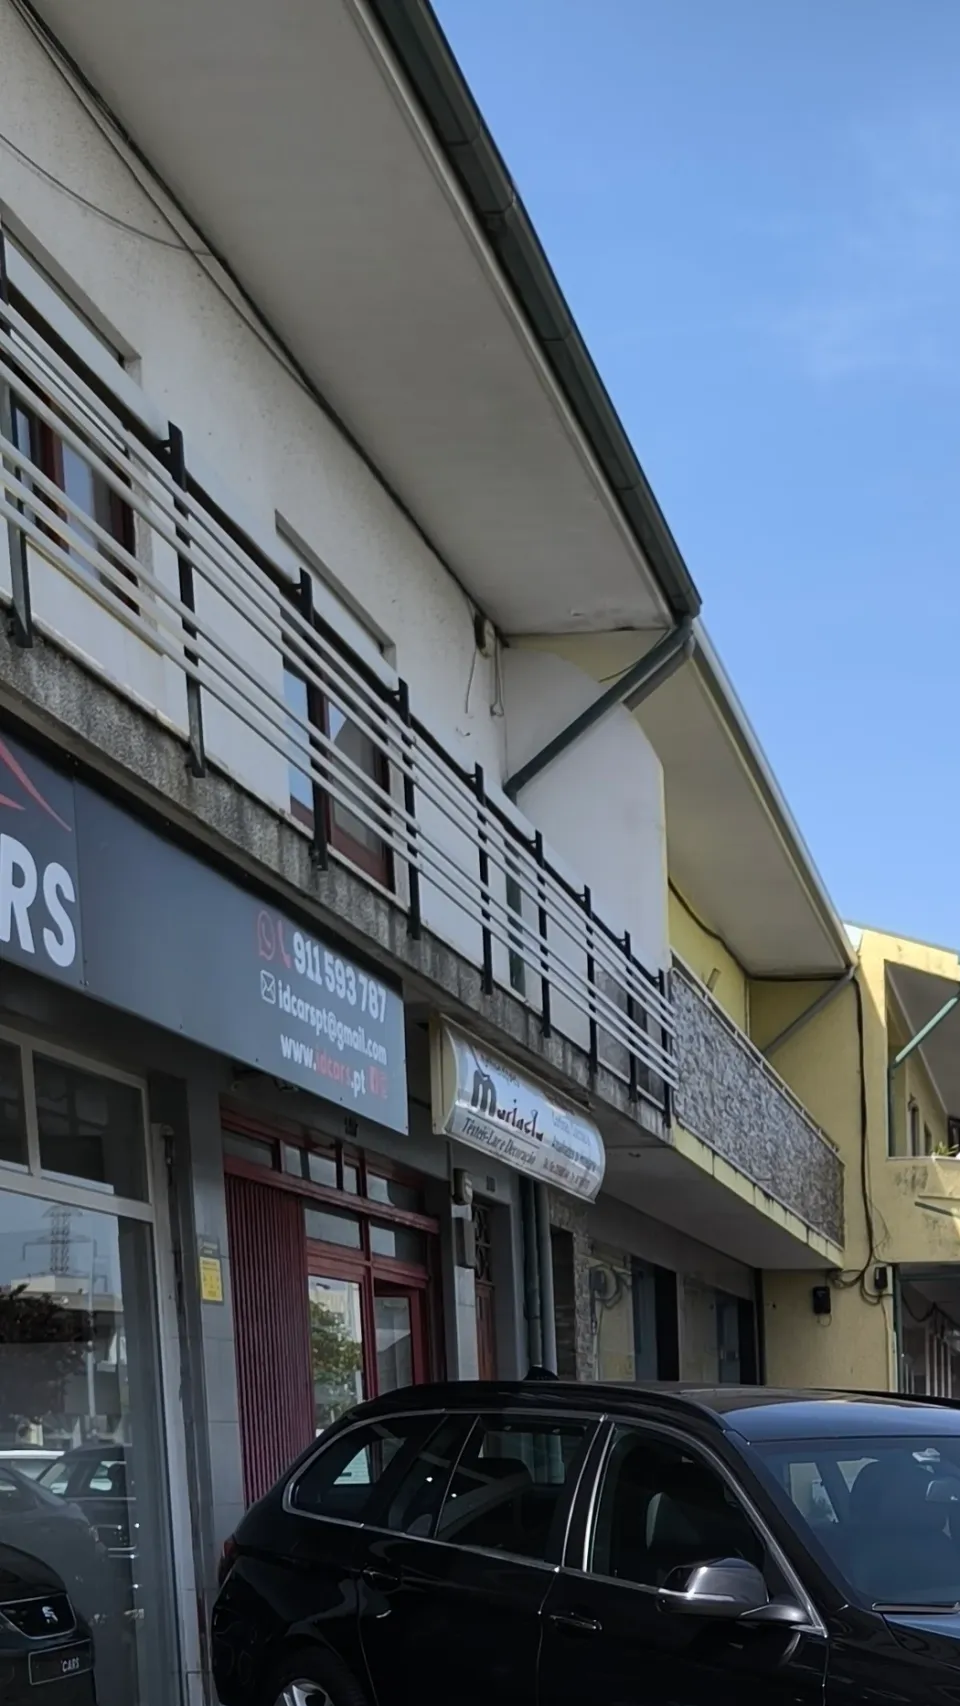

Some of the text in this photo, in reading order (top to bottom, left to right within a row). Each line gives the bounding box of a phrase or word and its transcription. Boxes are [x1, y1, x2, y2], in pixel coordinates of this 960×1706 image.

[293, 932, 386, 1023] 911 593 787
[278, 979, 387, 1065] idcarspt@gmail.com
[280, 1034, 366, 1097] www.idcars.pt
